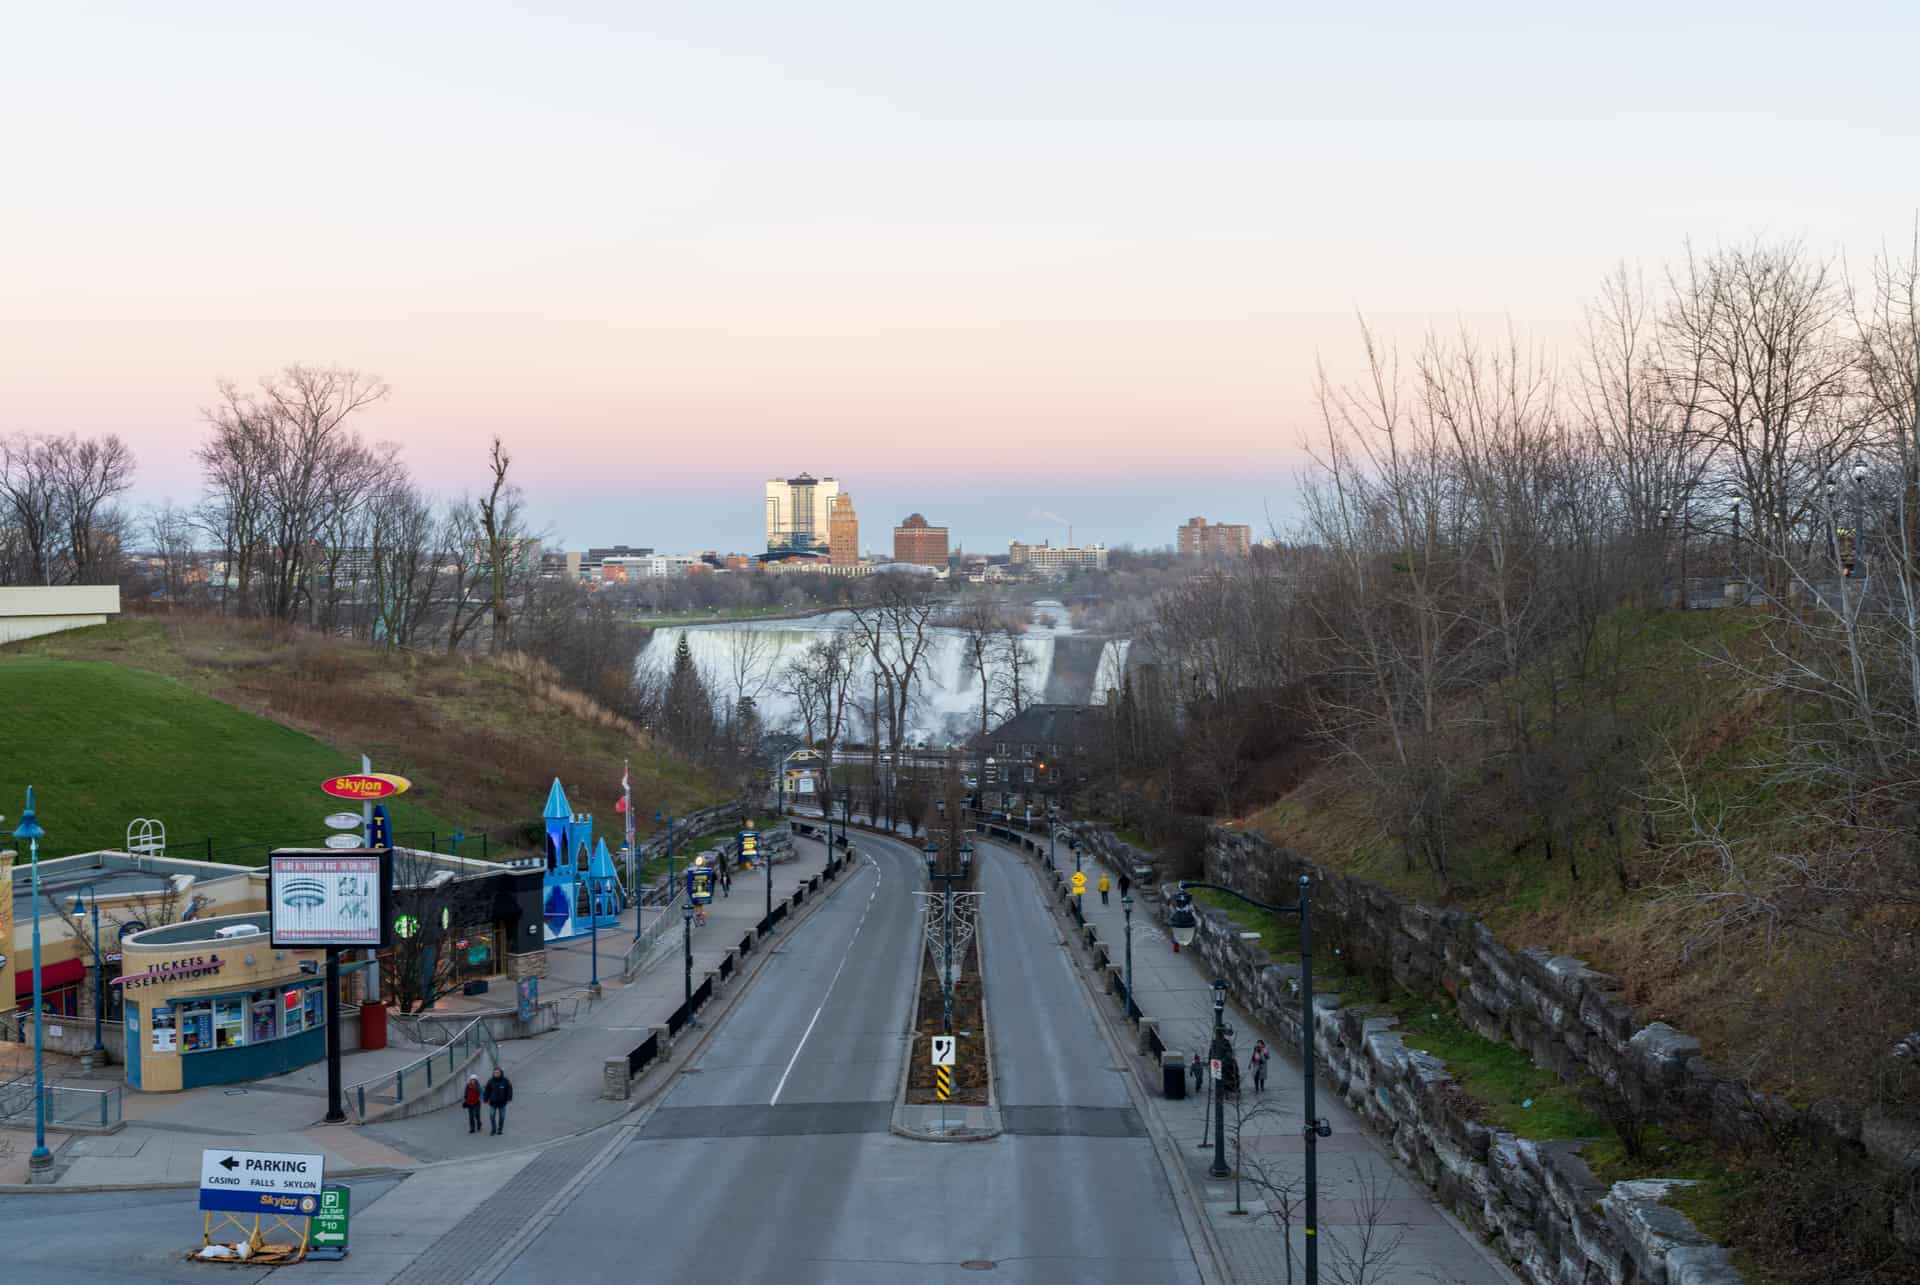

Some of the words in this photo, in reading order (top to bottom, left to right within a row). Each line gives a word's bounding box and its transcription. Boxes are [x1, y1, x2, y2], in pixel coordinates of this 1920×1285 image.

[336, 779, 382, 792] Skylon
[147, 956, 204, 974] TICKETS
[126, 966, 220, 989] ESERVATIONS
[245, 1159, 307, 1173] PARKING
[208, 1176, 241, 1185] CASINO
[250, 1178, 275, 1187] FALLS
[283, 1180, 317, 1189] SKYLON
[260, 1195, 298, 1206] Skylon
[325, 1194, 336, 1205] P
